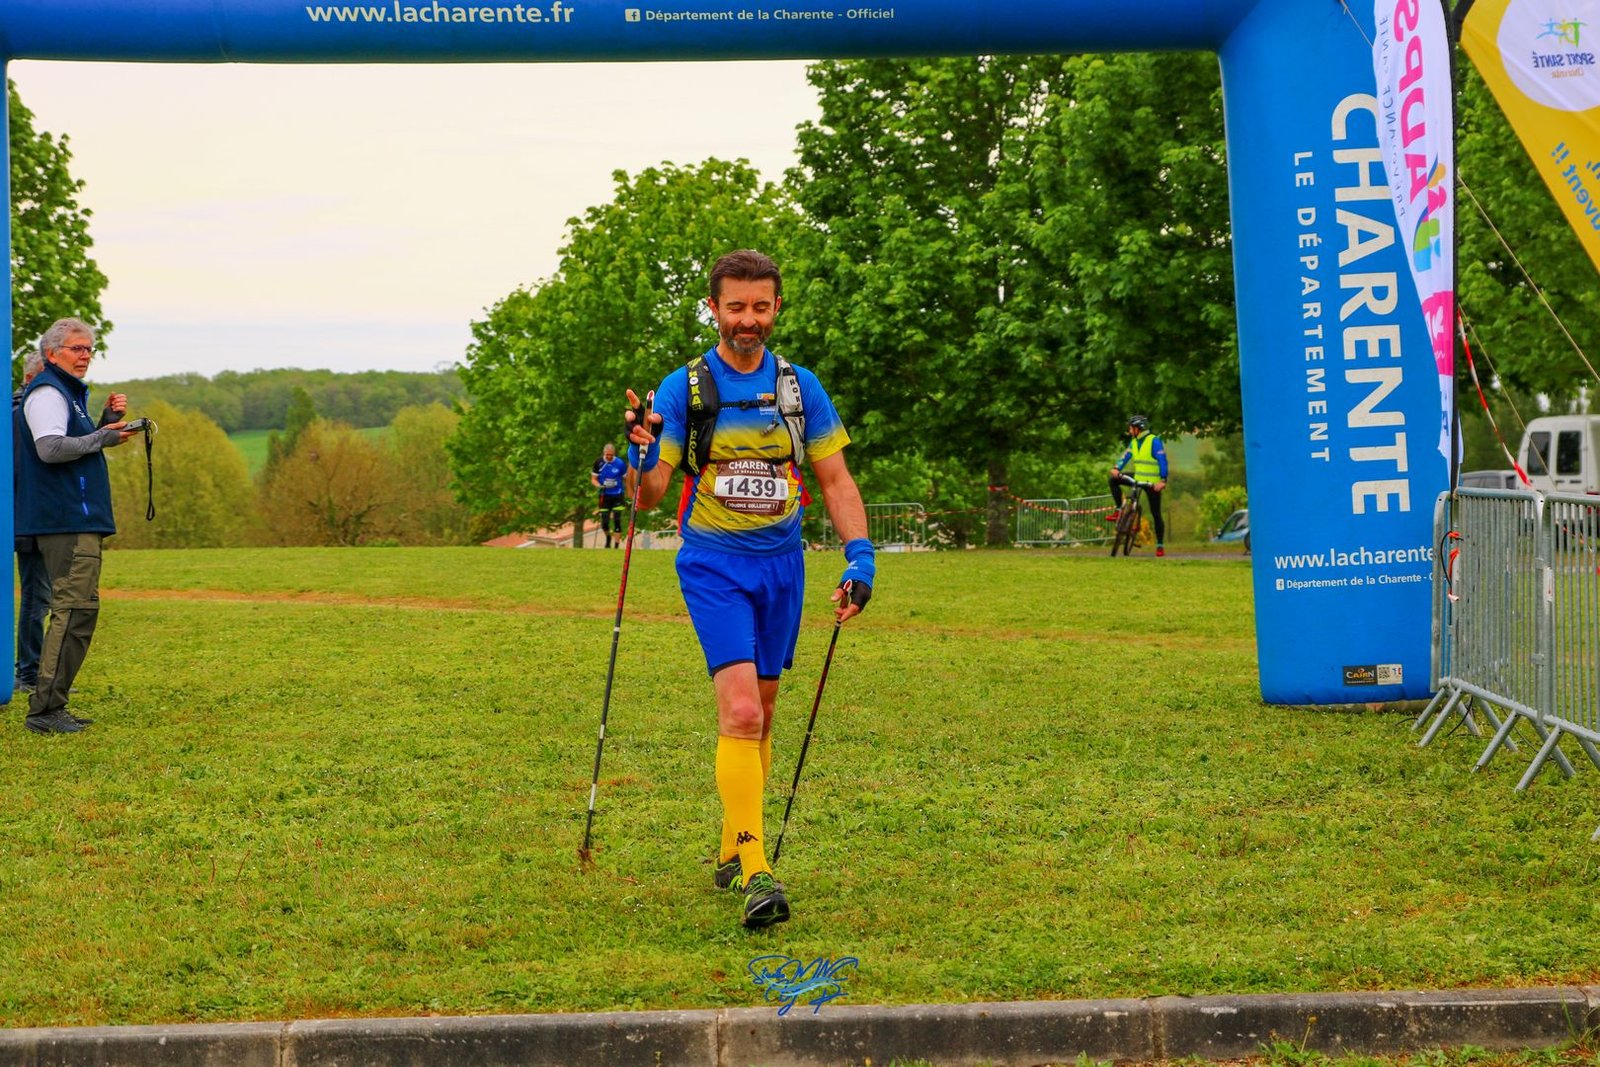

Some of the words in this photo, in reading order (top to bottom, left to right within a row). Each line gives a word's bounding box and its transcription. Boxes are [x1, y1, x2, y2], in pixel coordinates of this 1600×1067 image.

[306, 0, 574, 23] www.lacharente.fr
[646, 10, 733, 22] Département
[737, 10, 754, 20] de
[758, 10, 769, 20] la
[773, 9, 834, 20] Charente
[846, 8, 895, 19] Officiel
[1294, 151, 1315, 188] LE
[1331, 93, 1411, 515] CHARENTE
[1297, 207, 1330, 462] DÉPARTEMENT
[725, 477, 777, 498] 1439
[1287, 577, 1348, 589] Département
[1350, 576, 1364, 586] de
[1366, 574, 1376, 585] la
[1378, 573, 1422, 584] Charente
